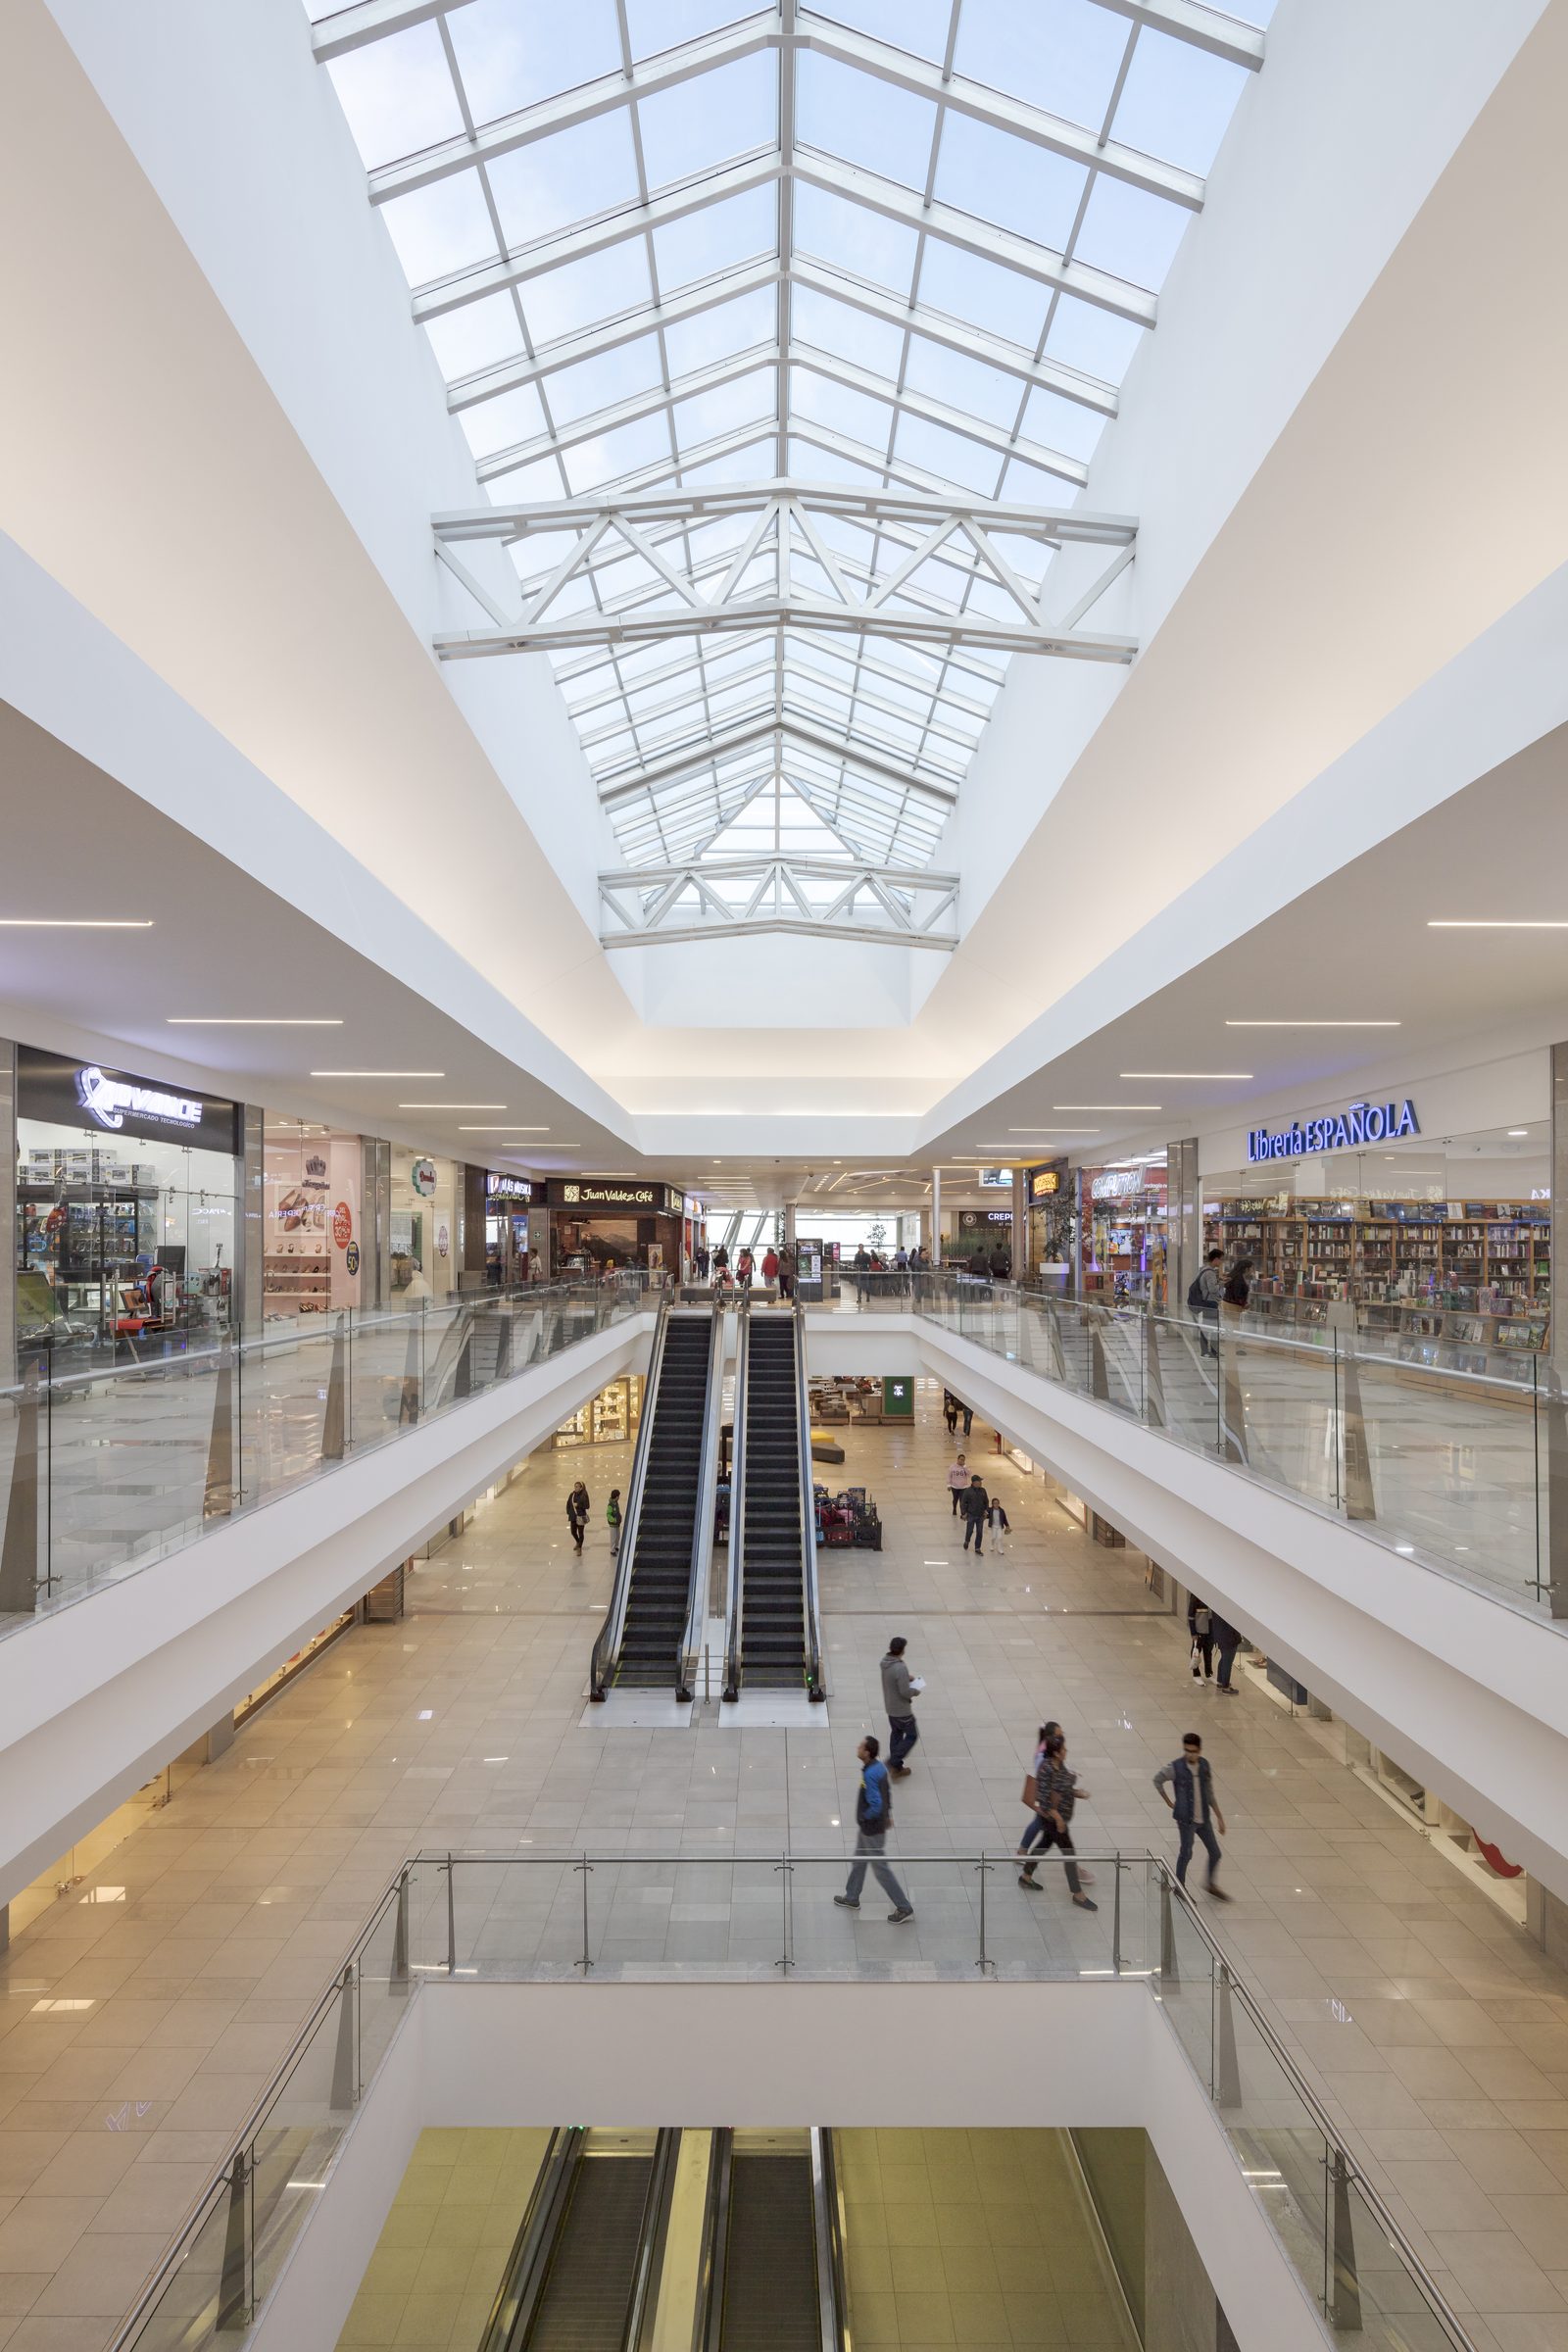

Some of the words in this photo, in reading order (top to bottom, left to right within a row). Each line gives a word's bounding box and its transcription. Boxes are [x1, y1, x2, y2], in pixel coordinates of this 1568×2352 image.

[113, 1106, 159, 1122] SUPERMERCADO
[1248, 1122, 1302, 1161] Librería
[1305, 1099, 1420, 1152] ESPAÑOLA
[580, 1188, 605, 1200] Juan
[605, 1190, 635, 1201] Valdez
[636, 1191, 654, 1202] Café
[988, 1212, 1026, 1221] CREP
